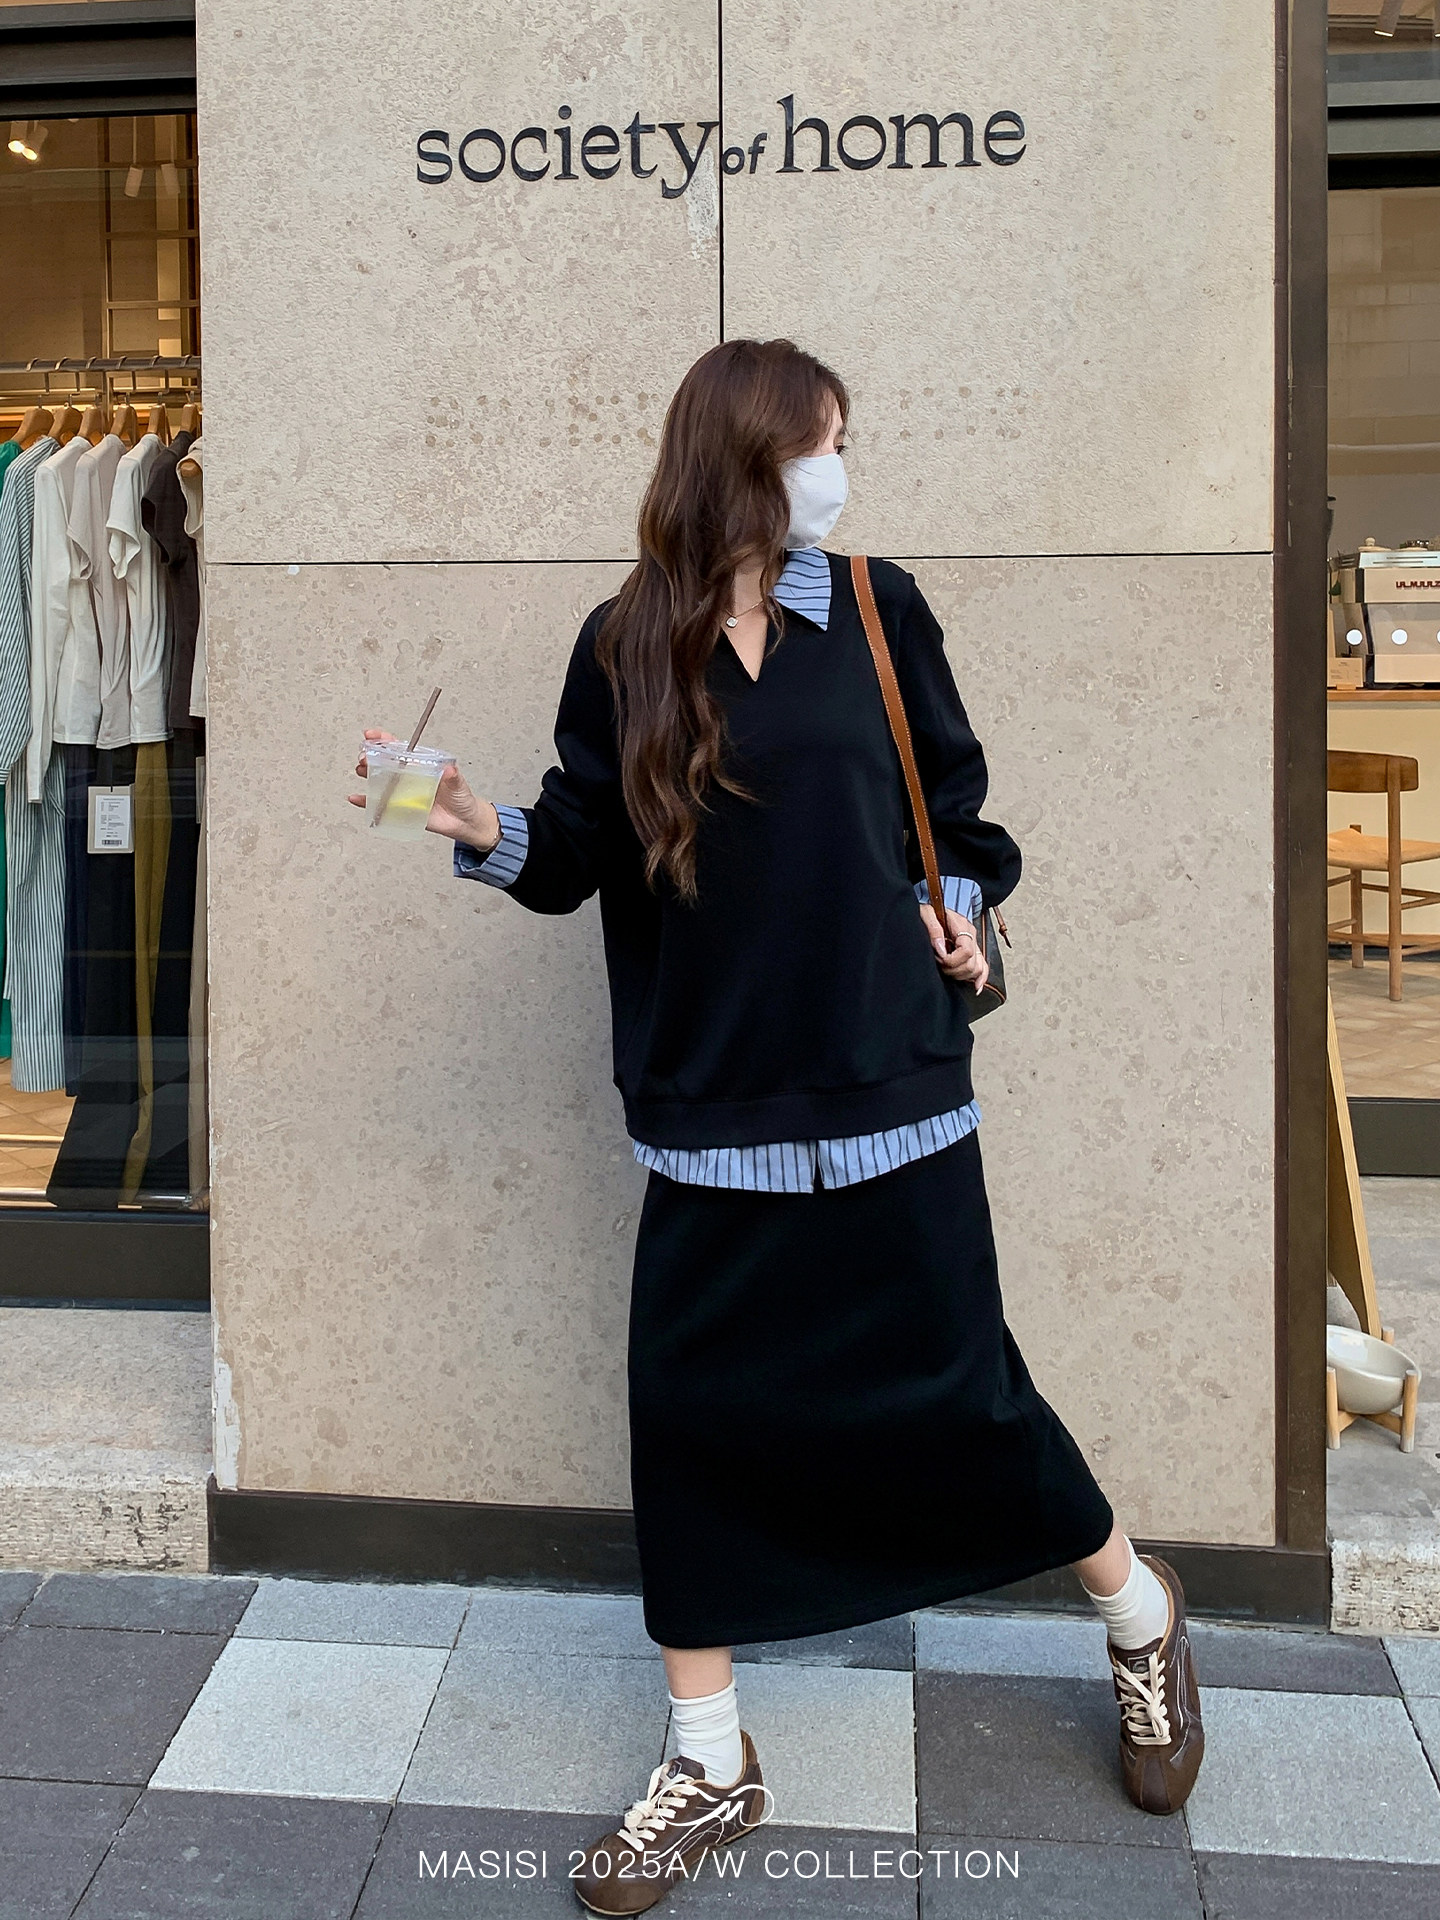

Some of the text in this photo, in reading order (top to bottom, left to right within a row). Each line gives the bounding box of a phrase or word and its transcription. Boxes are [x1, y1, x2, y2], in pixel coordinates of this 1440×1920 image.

[416, 93, 1028, 199] society of home
